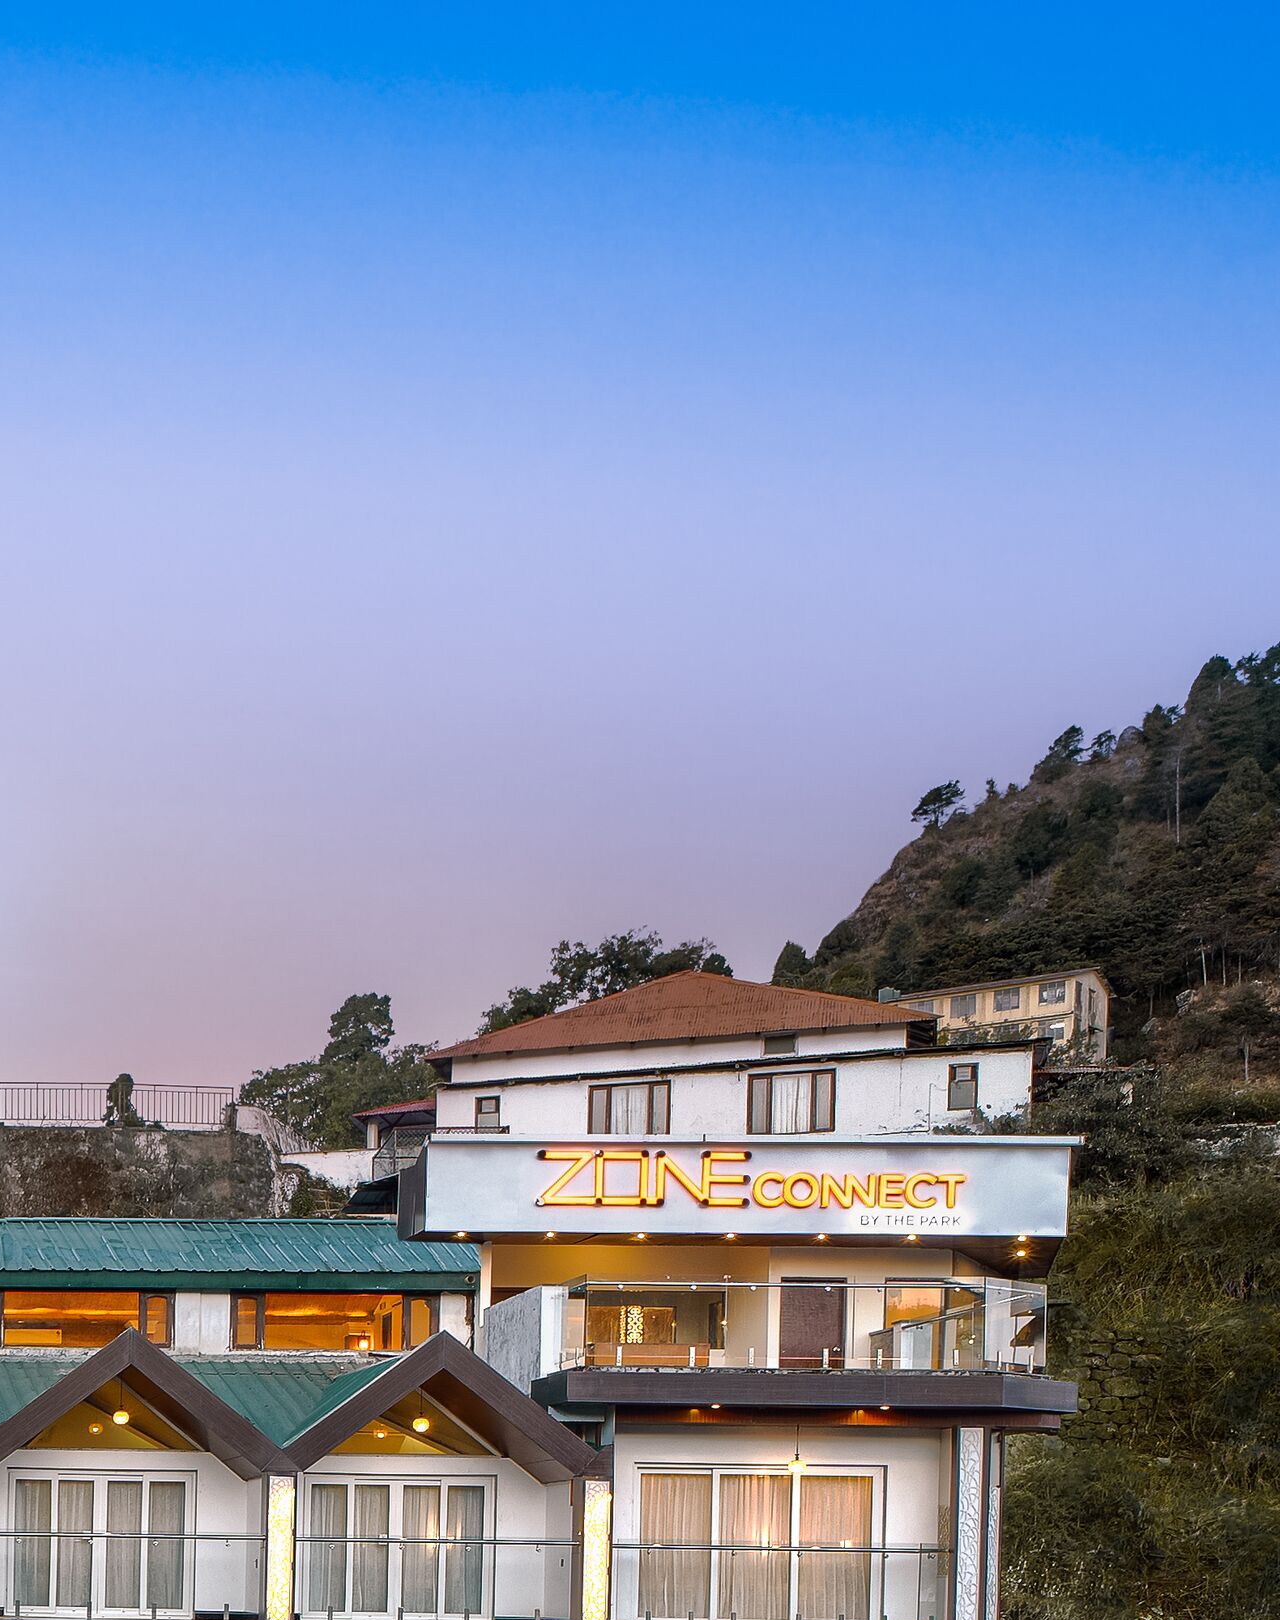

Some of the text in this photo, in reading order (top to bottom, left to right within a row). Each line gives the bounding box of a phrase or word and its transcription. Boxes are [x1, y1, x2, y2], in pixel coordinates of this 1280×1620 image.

[535, 1148, 968, 1209] ZONE CONNECT
[860, 1215, 961, 1226] BY THE PARK
